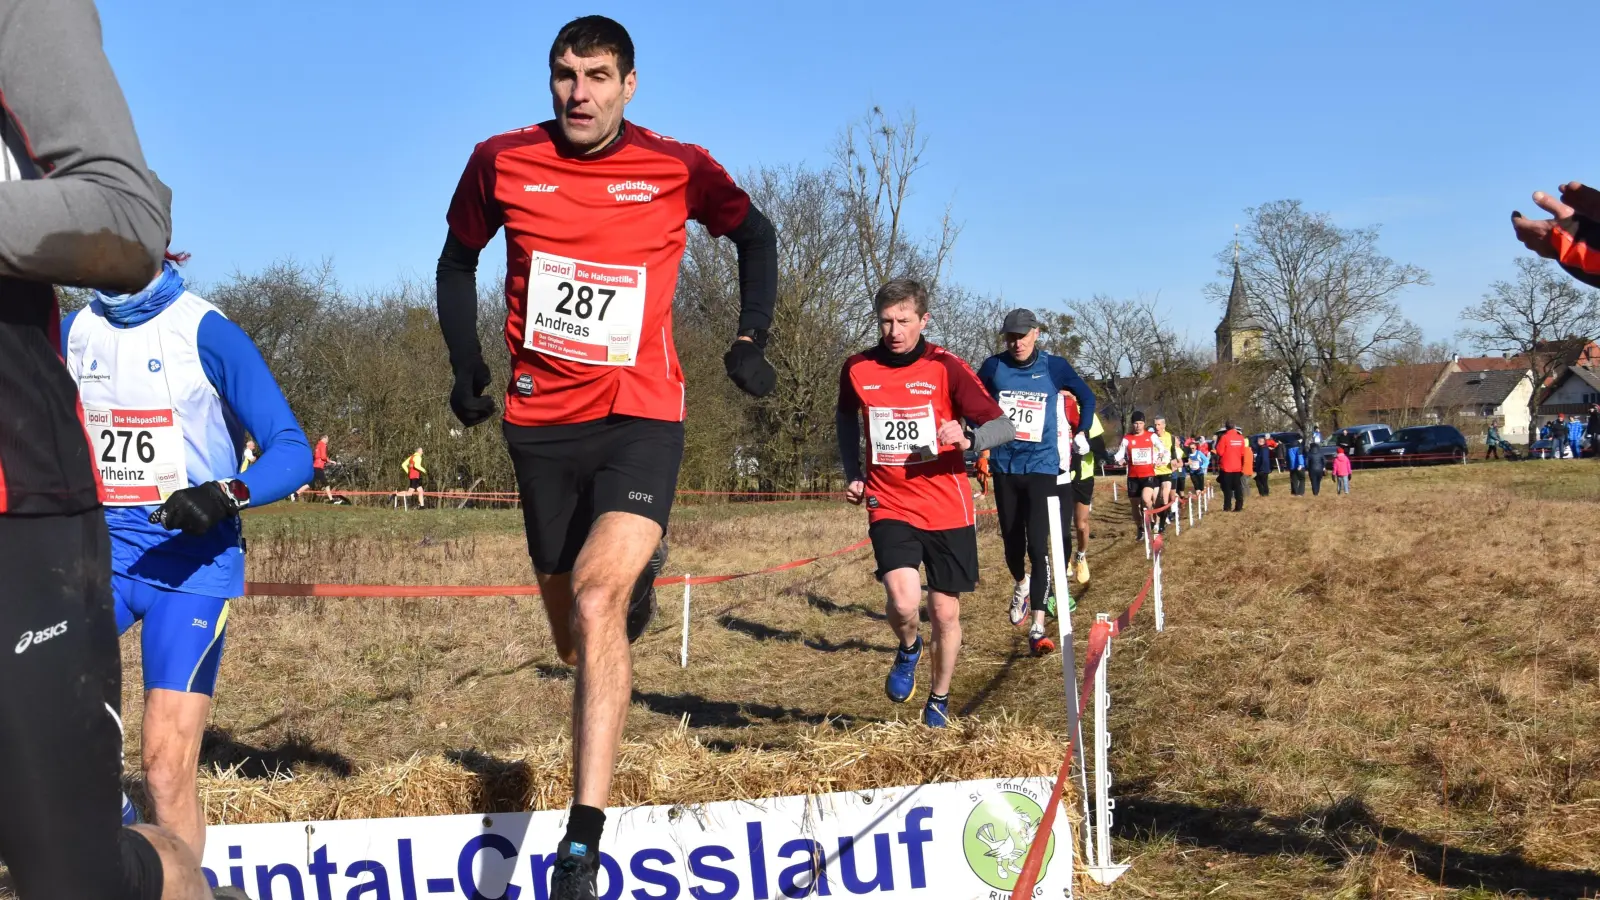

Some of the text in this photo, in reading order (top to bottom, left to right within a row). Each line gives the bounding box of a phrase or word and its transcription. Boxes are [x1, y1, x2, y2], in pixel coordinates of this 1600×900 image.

[607, 180, 660, 194] Gerüstbau
[615, 193, 652, 202] Wundel
[542, 261, 572, 276] ipalat
[577, 270, 635, 284] Die Halspastille.
[555, 281, 616, 321] 287
[534, 312, 590, 338] Andreas
[114, 415, 170, 425] Die Halspastille.
[1009, 407, 1033, 423] 216
[884, 420, 919, 440] 288
[100, 429, 155, 463] 276
[628, 491, 654, 504] GORE
[33, 620, 68, 645] asics
